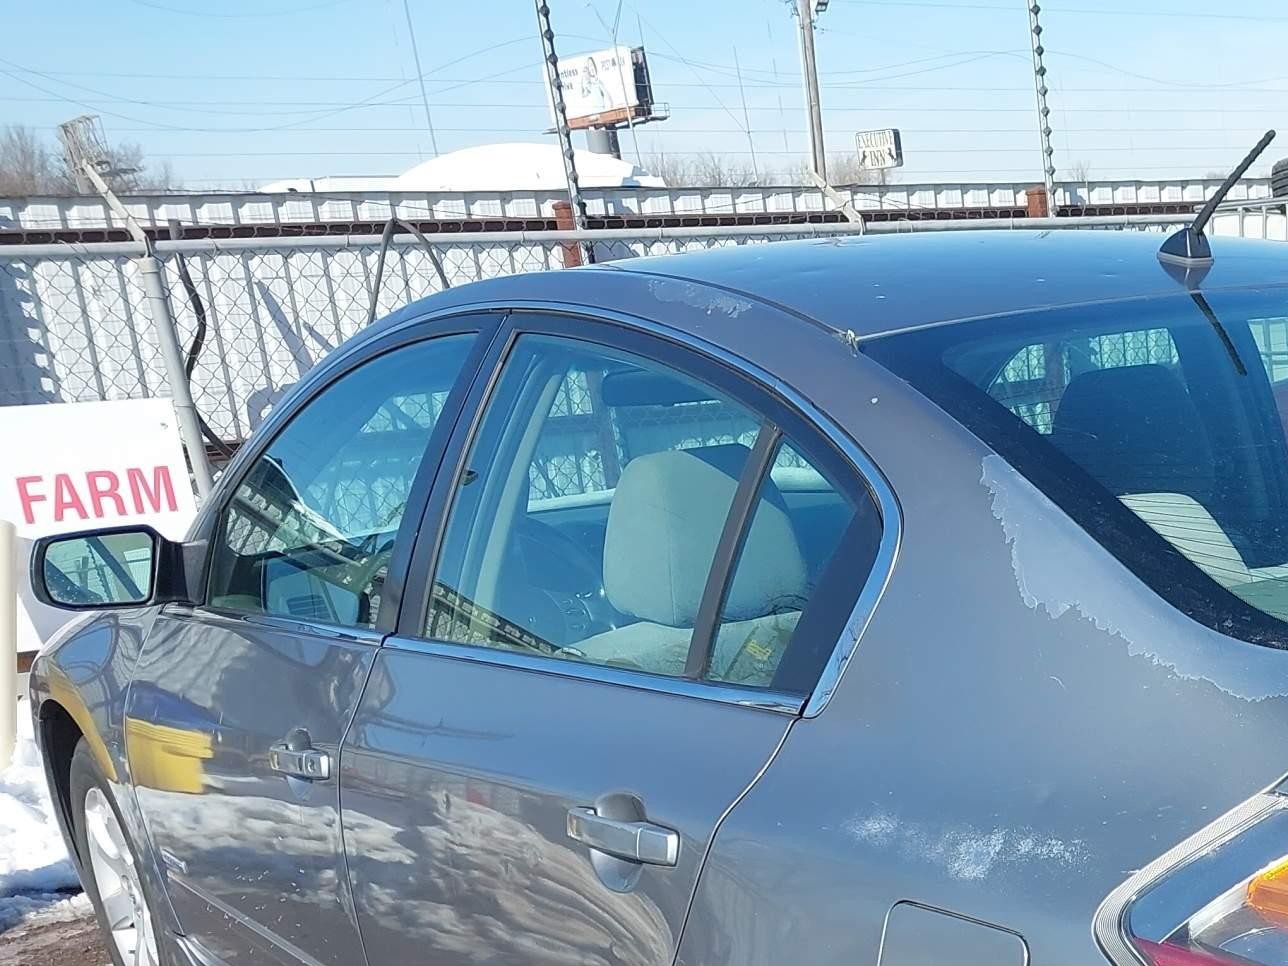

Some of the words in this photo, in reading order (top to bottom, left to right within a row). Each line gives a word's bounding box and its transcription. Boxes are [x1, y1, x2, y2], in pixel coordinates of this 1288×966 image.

[857, 130, 894, 149] EXECUTIVE
[869, 149, 886, 167] INN
[16, 465, 179, 524] FARM
